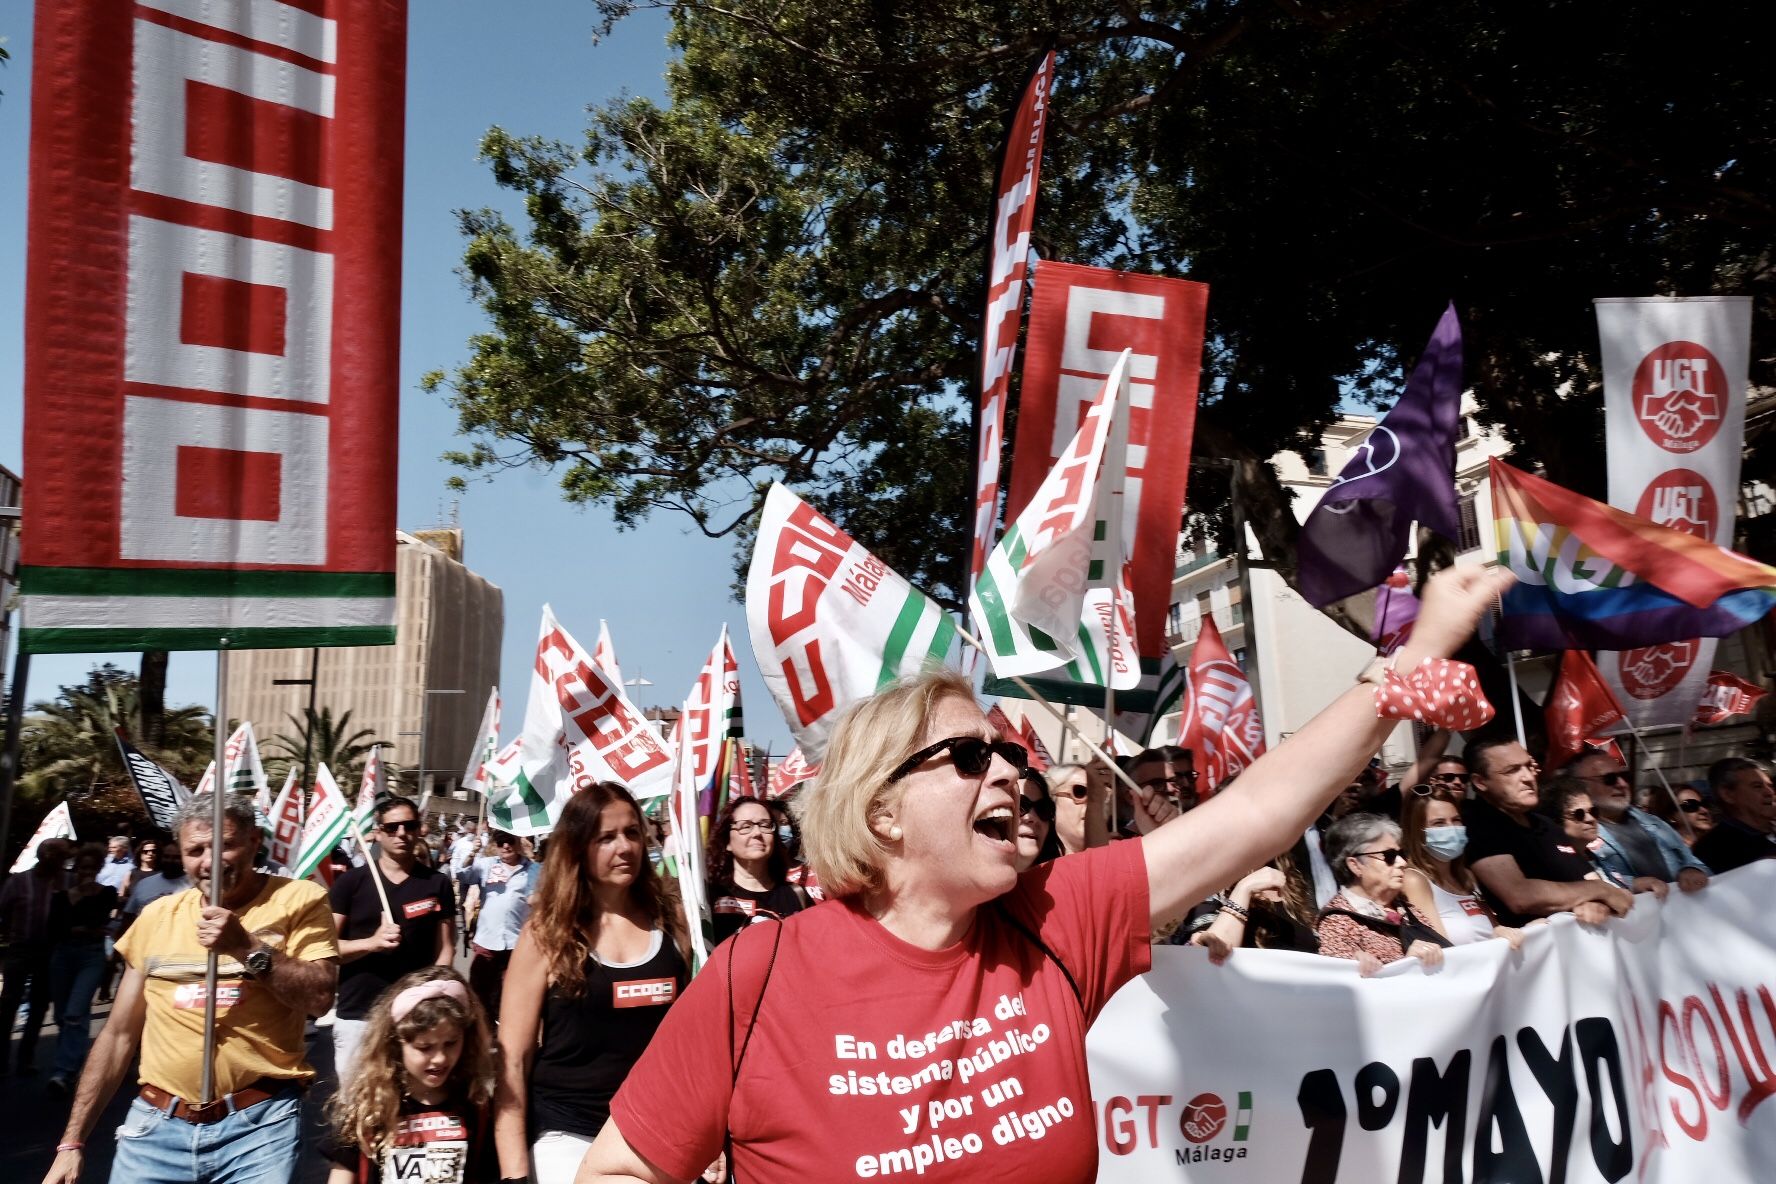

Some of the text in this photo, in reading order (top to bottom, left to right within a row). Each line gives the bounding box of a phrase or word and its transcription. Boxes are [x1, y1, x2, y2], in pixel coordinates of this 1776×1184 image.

[1653, 358, 1708, 397] UGT
[1651, 486, 1703, 524] UGT
[840, 551, 893, 608] Mála
[834, 991, 1027, 1060] En defensa del
[828, 1022, 1051, 1096] sistema público
[898, 1076, 1024, 1135] y por un
[855, 1096, 1075, 1178] empleo digno
[1175, 1144, 1249, 1166] Málaga
[392, 1153, 455, 1180] VANS
